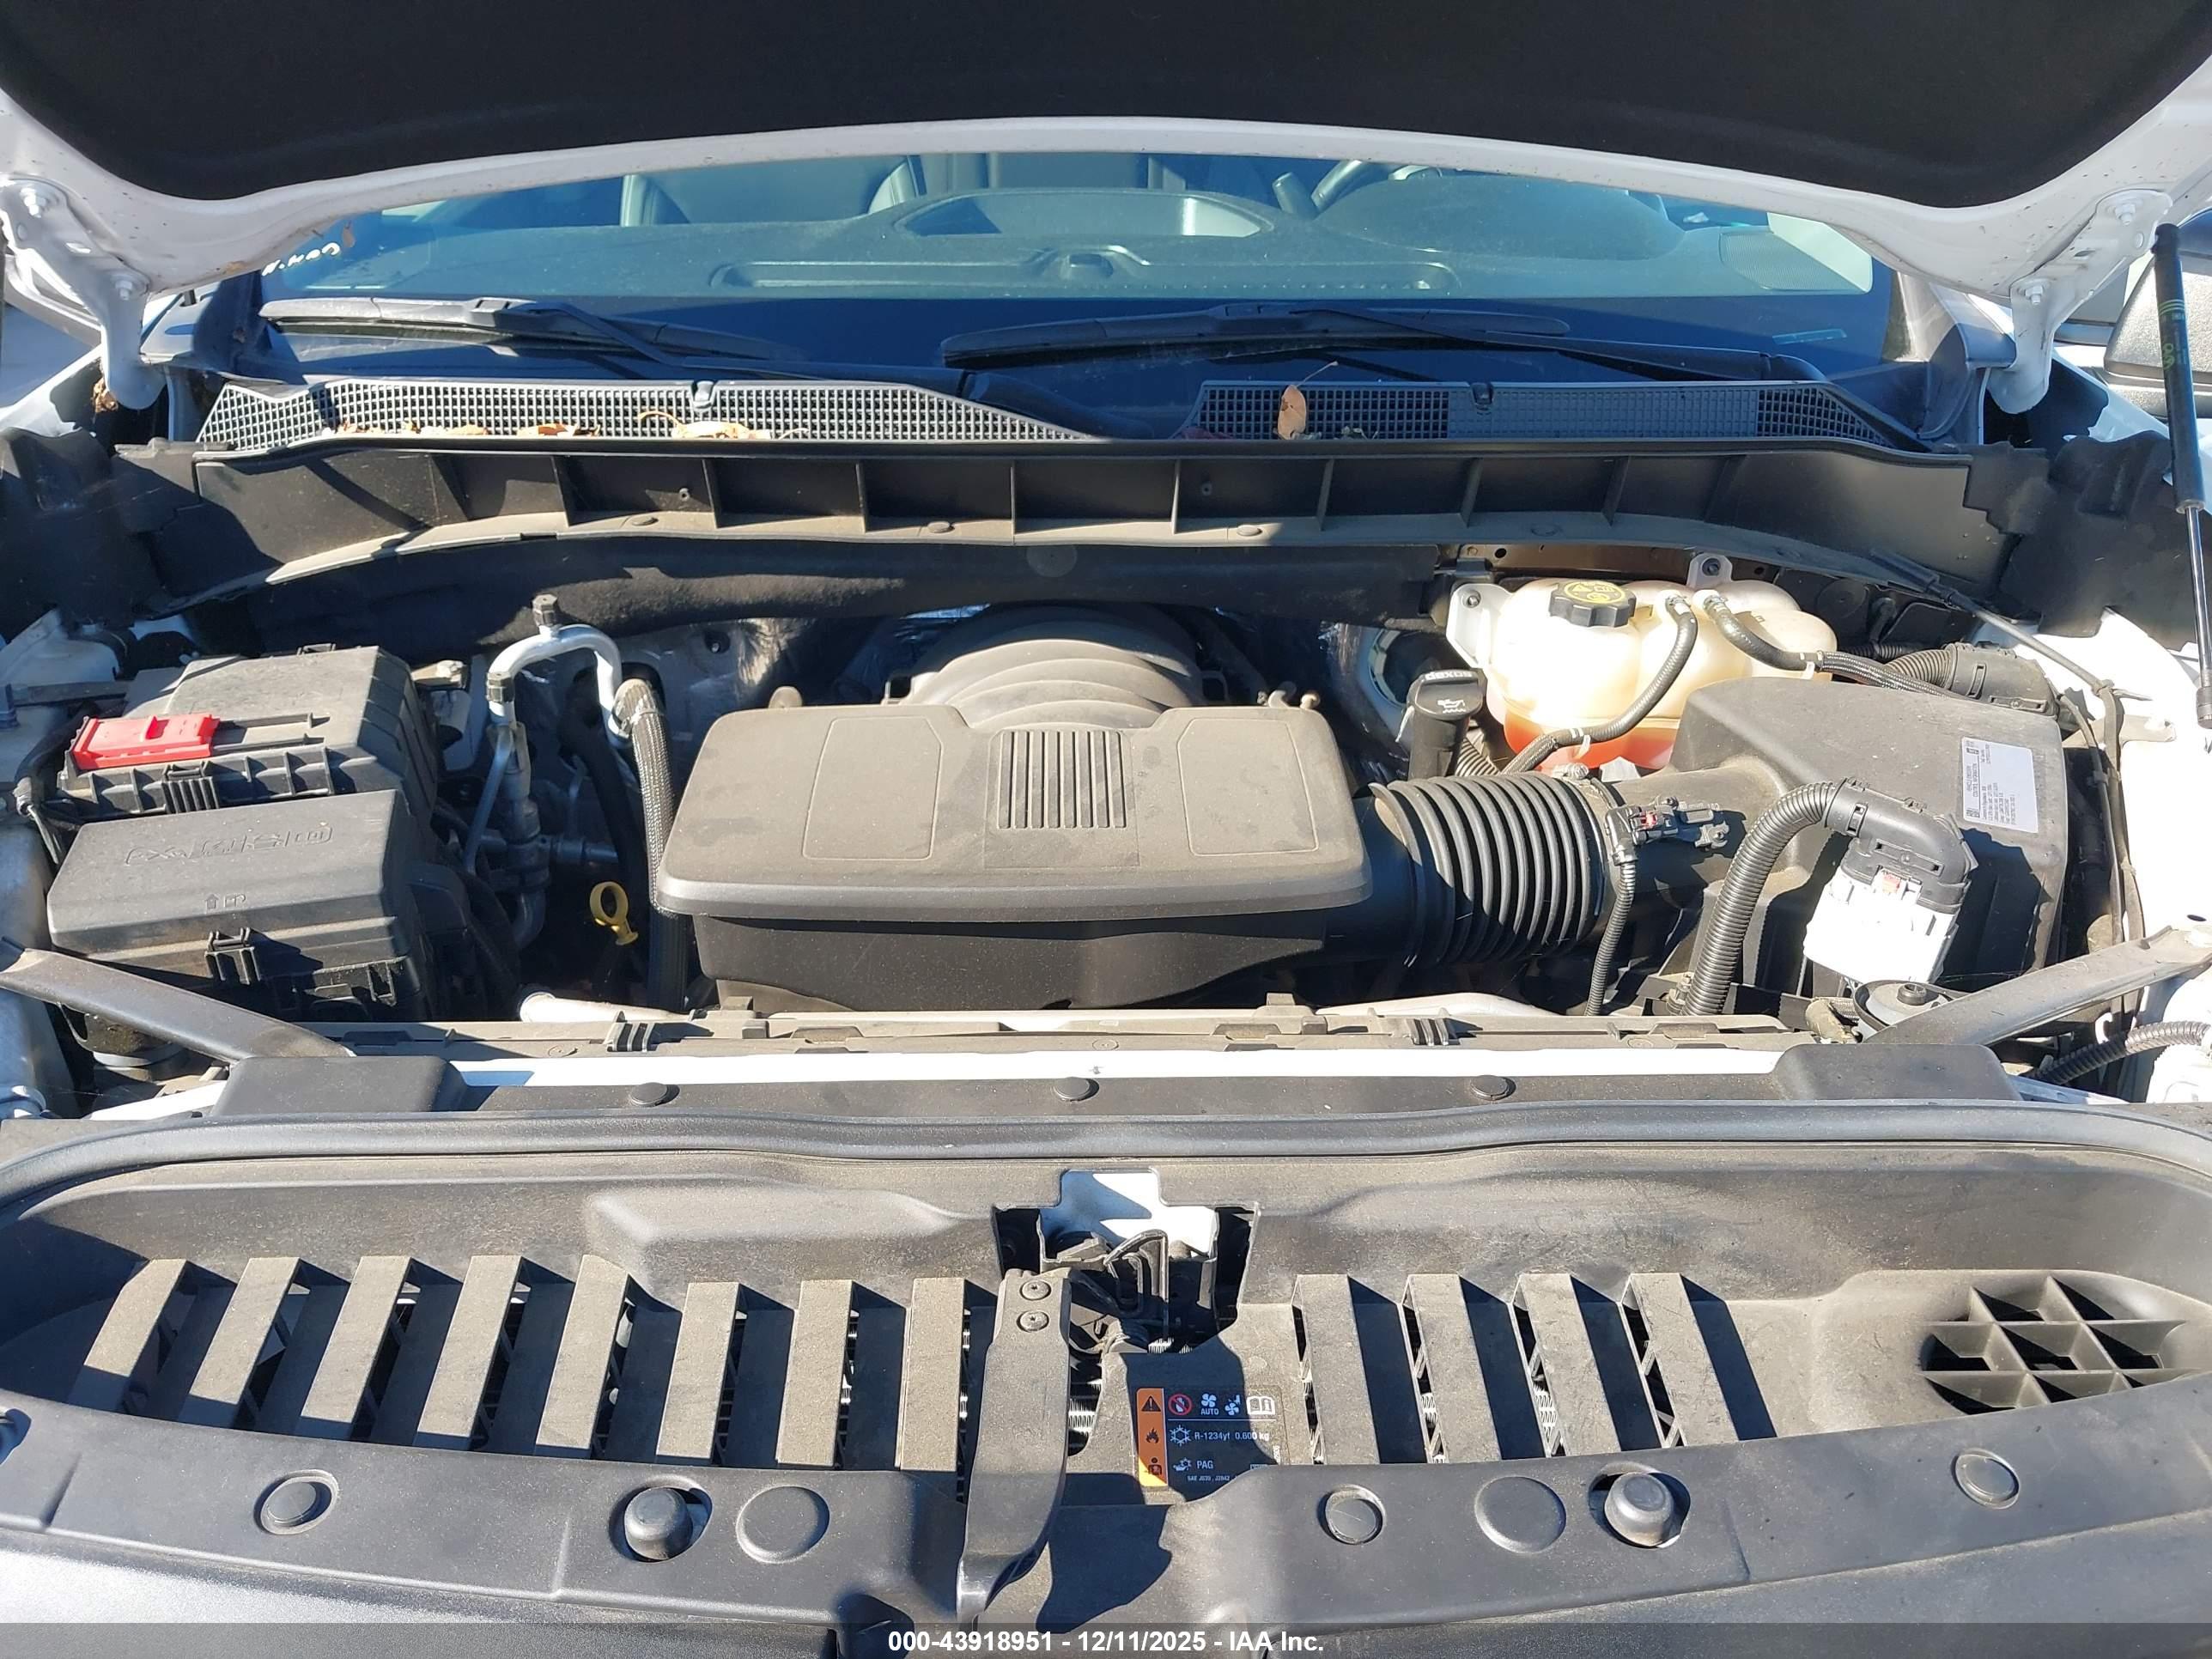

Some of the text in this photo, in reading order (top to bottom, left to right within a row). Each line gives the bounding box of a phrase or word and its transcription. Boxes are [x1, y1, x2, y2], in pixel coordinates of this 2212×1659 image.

[1200, 1407, 1219, 1416] AUTO
[1235, 1431, 1258, 1441] 0.600
[1259, 1431, 1270, 1442] kg
[1197, 1460, 1214, 1469] PAG
